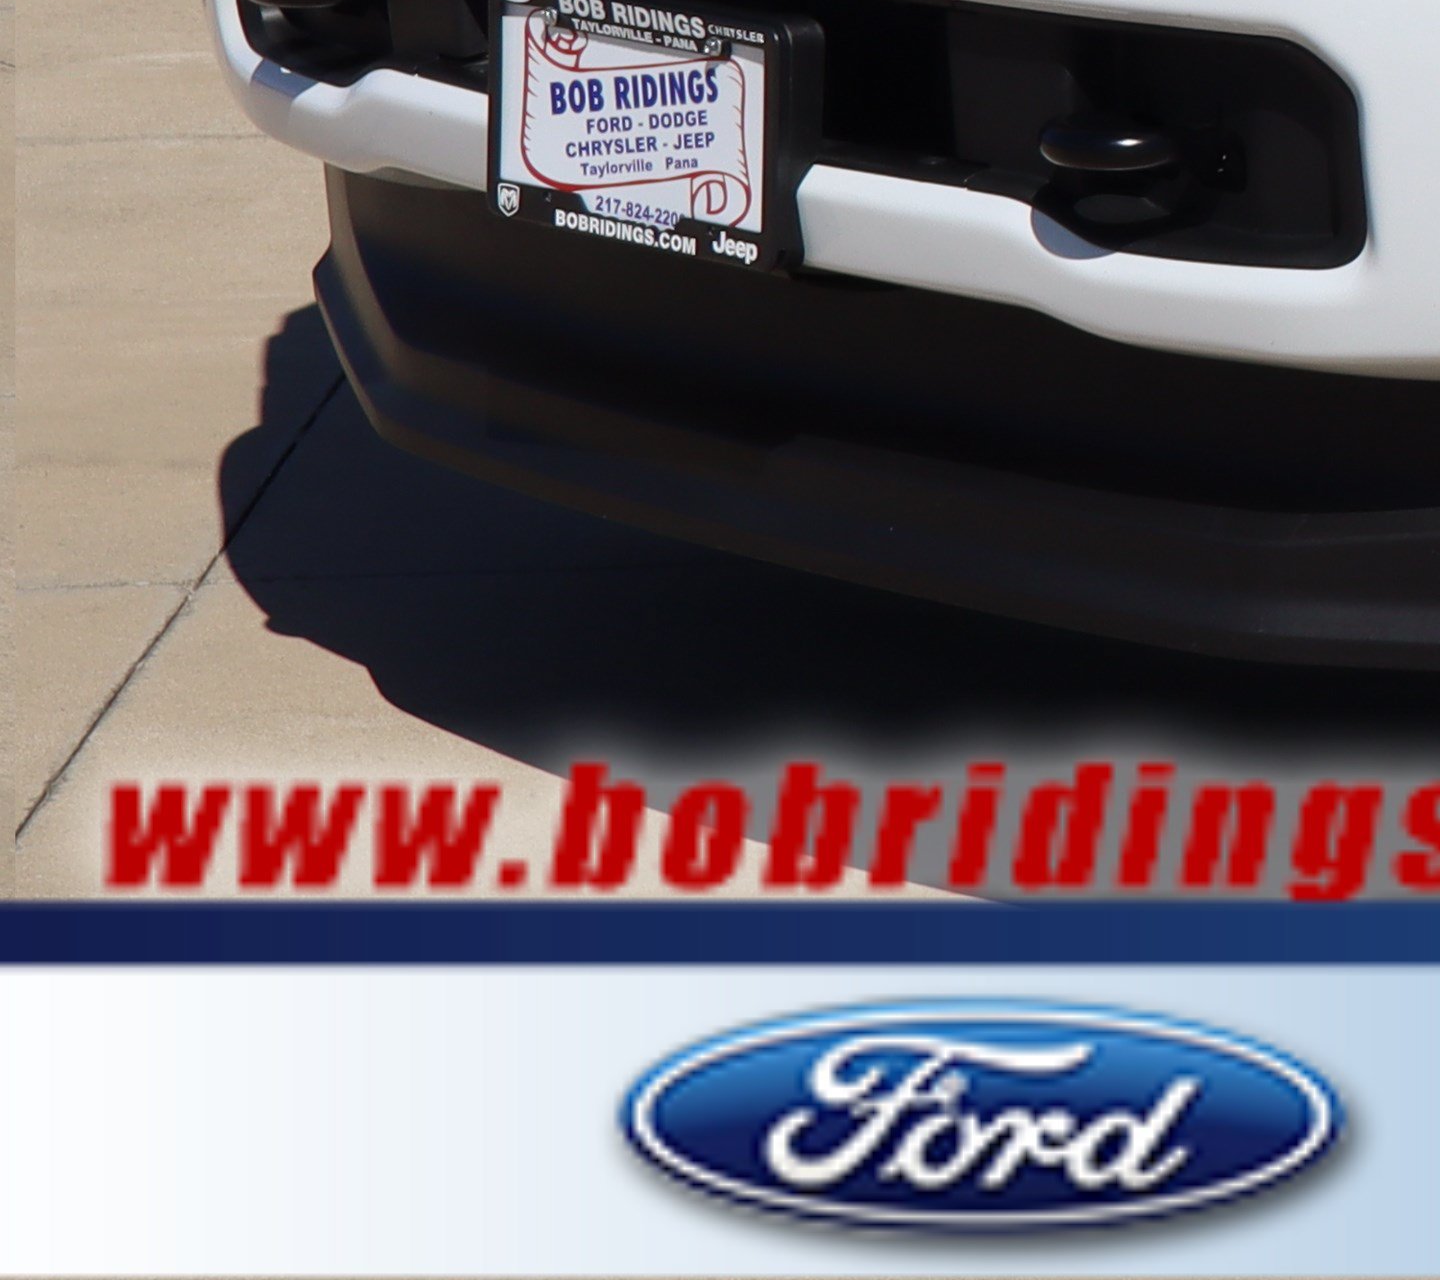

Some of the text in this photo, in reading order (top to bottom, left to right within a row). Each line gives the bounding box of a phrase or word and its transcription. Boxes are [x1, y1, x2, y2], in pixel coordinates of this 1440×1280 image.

[571, 18, 654, 44] TAYLORVILLE
[663, 34, 698, 53] PANA
[611, 2, 706, 39] RIDINGS
[707, 24, 765, 43] CHRYSLER
[550, 68, 719, 116] BOB RIDINGS
[586, 117, 632, 134] FORD
[649, 110, 708, 130] DODGE
[565, 136, 657, 158] CHRYSLER
[673, 132, 715, 150] JEEP
[580, 156, 699, 178] Taylorville Pana
[555, 208, 697, 256] BOBRIDINGS.COM
[712, 231, 759, 265] Jeep
